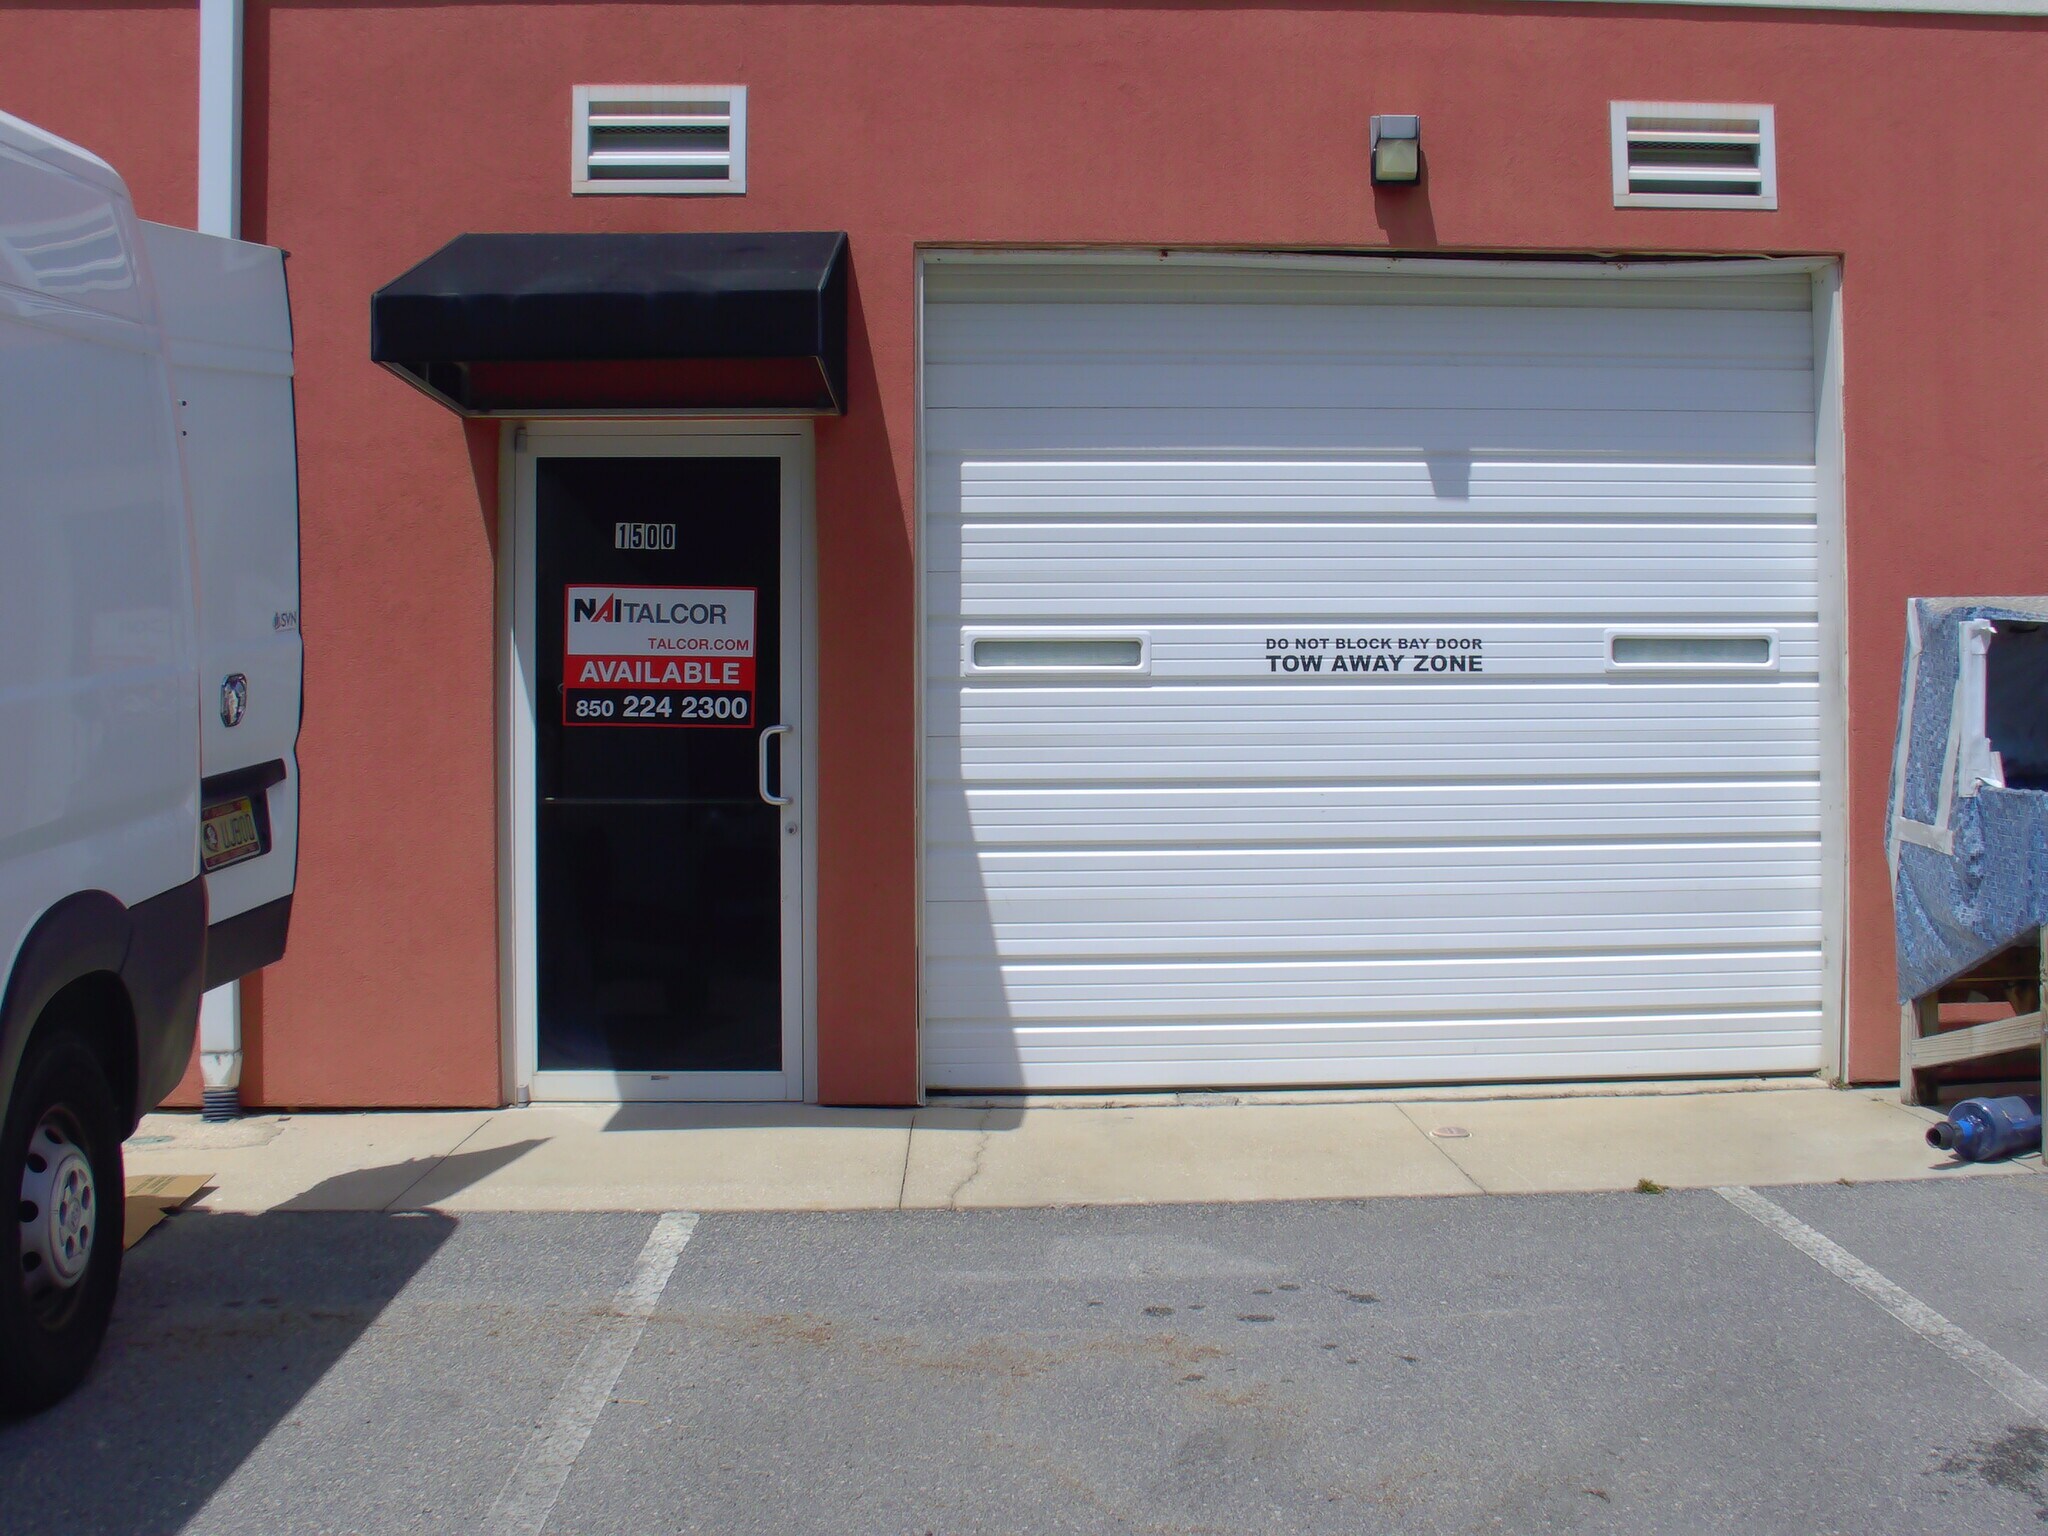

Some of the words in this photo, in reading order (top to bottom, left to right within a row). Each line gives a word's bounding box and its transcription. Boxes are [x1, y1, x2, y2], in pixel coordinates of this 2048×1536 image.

[619, 524, 674, 549] 1500
[648, 638, 749, 651] TALCOR.COM
[1266, 638, 1289, 649] DO
[1295, 638, 1329, 649] NOT
[1335, 638, 1392, 649] BLOCK
[1398, 638, 1430, 649] BAY
[1436, 638, 1482, 649] DOOR
[579, 661, 740, 684] AVAILABLE
[1266, 655, 1323, 672] TOW
[1331, 655, 1404, 672] AWAY
[1413, 655, 1483, 672] ZONE
[576, 700, 614, 717] 850
[623, 696, 672, 718] 224
[681, 696, 748, 719] 2300
